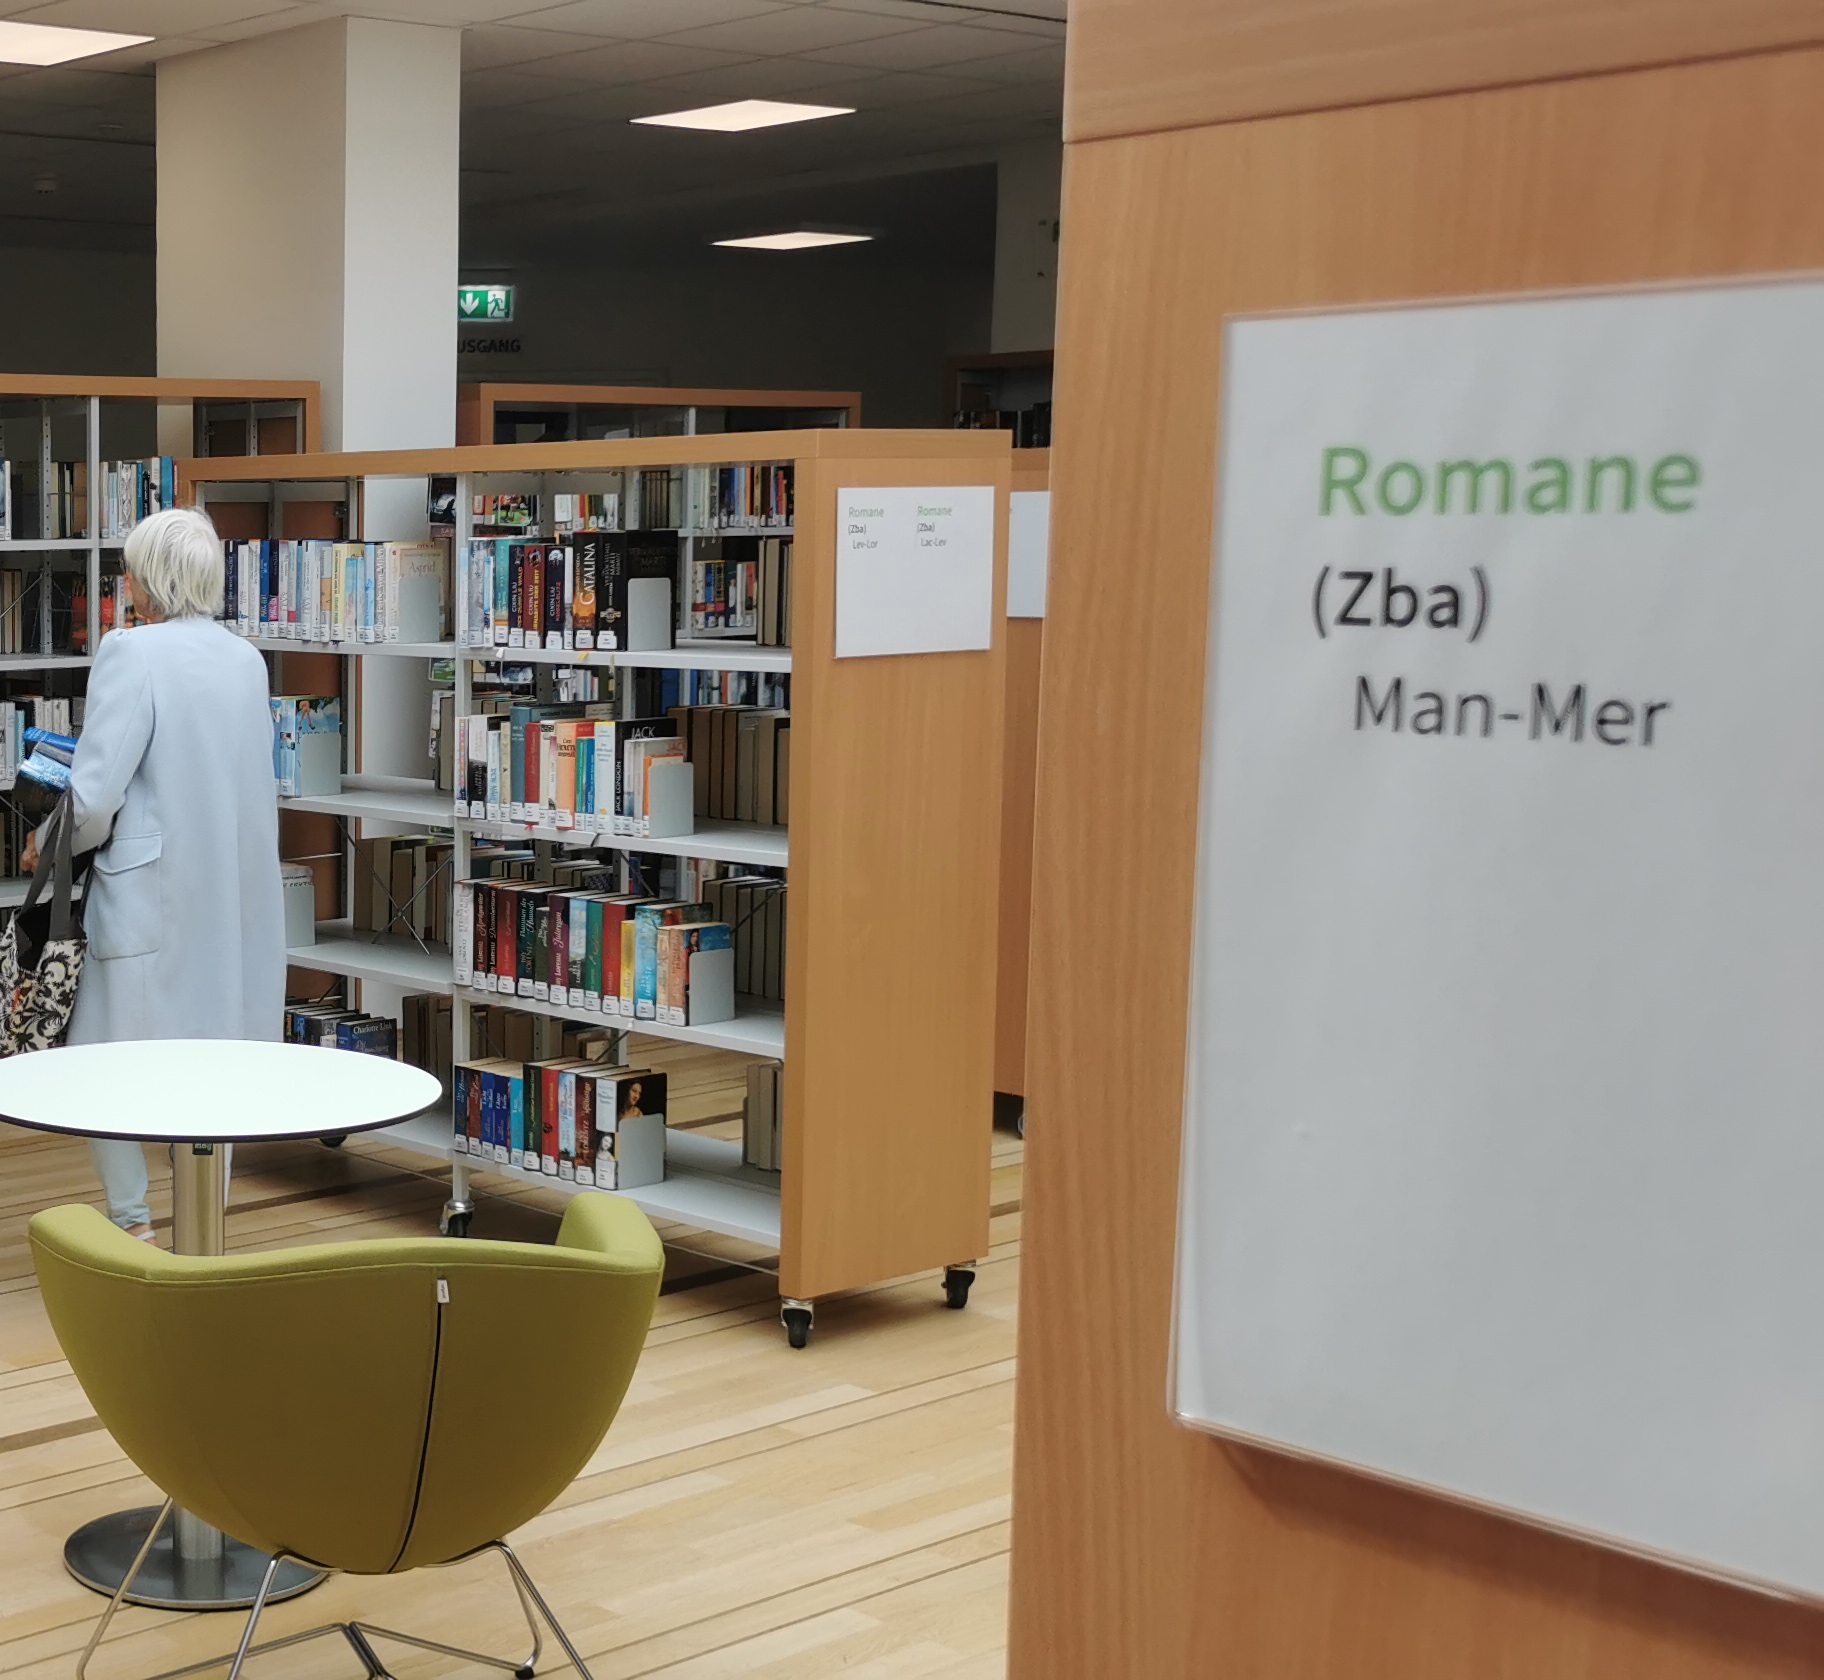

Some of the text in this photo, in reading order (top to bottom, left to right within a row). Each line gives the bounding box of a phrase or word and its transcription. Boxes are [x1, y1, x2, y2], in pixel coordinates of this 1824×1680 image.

[458, 339, 521, 353] USGANG
[1318, 446, 1702, 516] Romane
[848, 507, 885, 518] Romane
[917, 506, 953, 517] Romane
[848, 524, 867, 535] (Zba)
[917, 523, 935, 533] (Zba)
[852, 540, 879, 549] Lev-Lor
[578, 542, 596, 605] CATALINA
[1311, 565, 1490, 643] (Zba)
[1353, 675, 1673, 747] Man-Mer
[615, 760, 623, 794] LONDON
[353, 1023, 379, 1035] Charlotte
